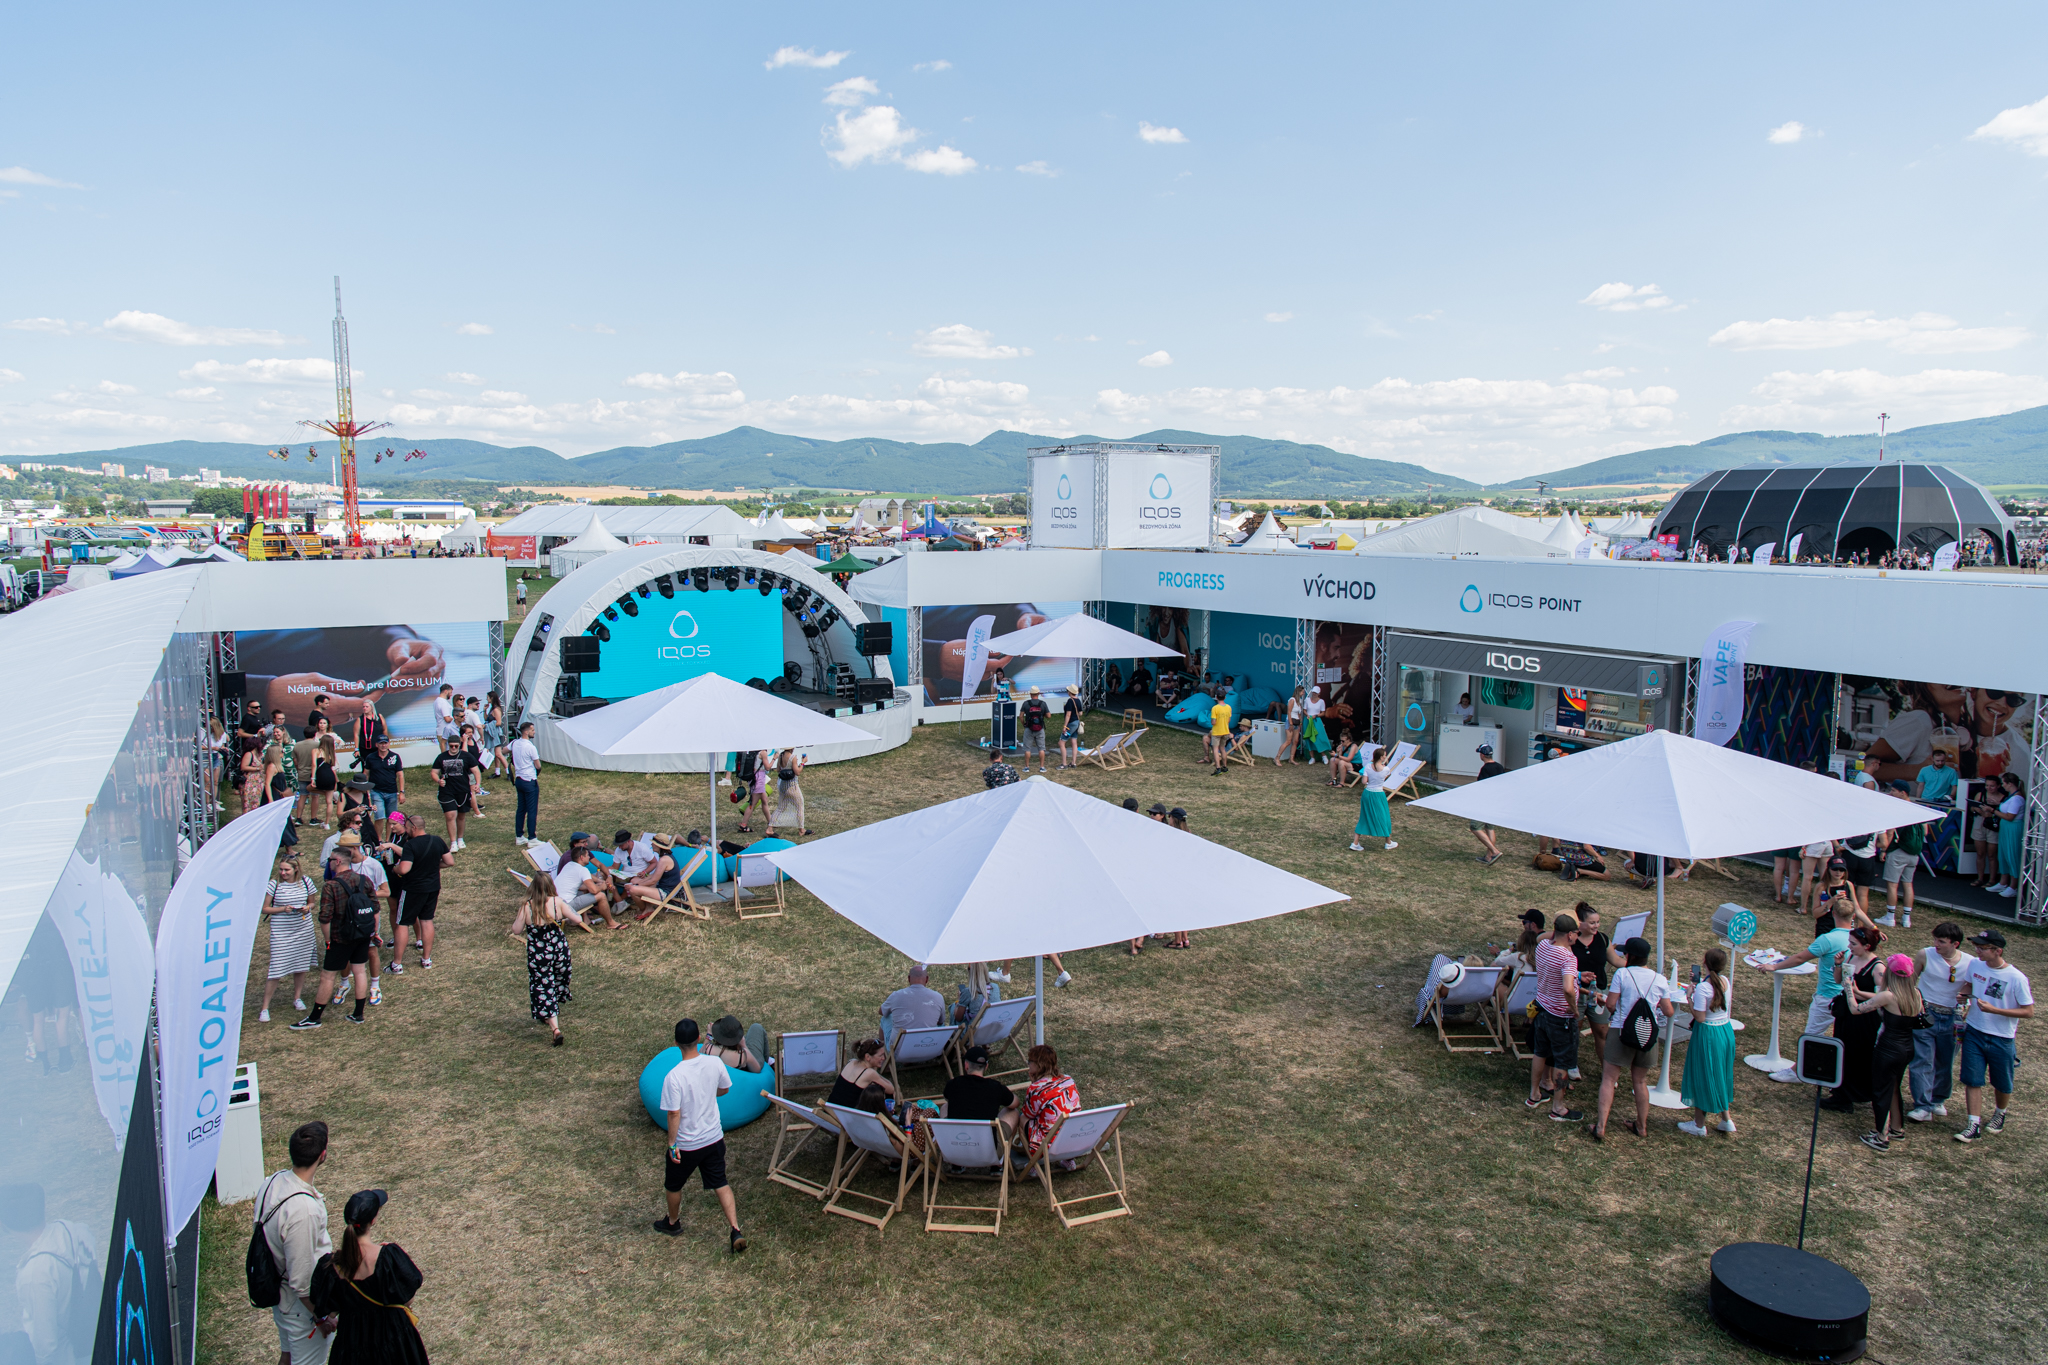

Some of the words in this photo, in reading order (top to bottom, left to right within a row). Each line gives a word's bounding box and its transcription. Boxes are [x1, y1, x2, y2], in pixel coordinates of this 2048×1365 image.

[1051, 507, 1077, 520] IQOS
[1139, 507, 1181, 520] IQOS
[1158, 571, 1225, 591] PROGRESS
[1303, 573, 1376, 600] VÝCHOD
[1488, 593, 1533, 609] IQOS
[1539, 597, 1582, 613] POINT
[971, 627, 982, 661] GAME
[1258, 632, 1291, 651] IQOS
[658, 645, 711, 660] IQOS
[1486, 651, 1541, 673] IQOS
[1729, 643, 1738, 668] POINT
[1271, 661, 1286, 674] na
[1712, 639, 1731, 687] VAPE
[287, 683, 327, 695] Náplne
[329, 682, 365, 692] TEREA
[367, 681, 384, 692] pre
[386, 677, 414, 688] IQOS
[416, 676, 450, 687] ILUMA
[1495, 685, 1522, 696] ILUMA
[1642, 688, 1661, 696] IQOS
[357, 906, 373, 914] NASA
[198, 885, 233, 1079] TOALETY
[187, 1114, 222, 1143] IQOS
